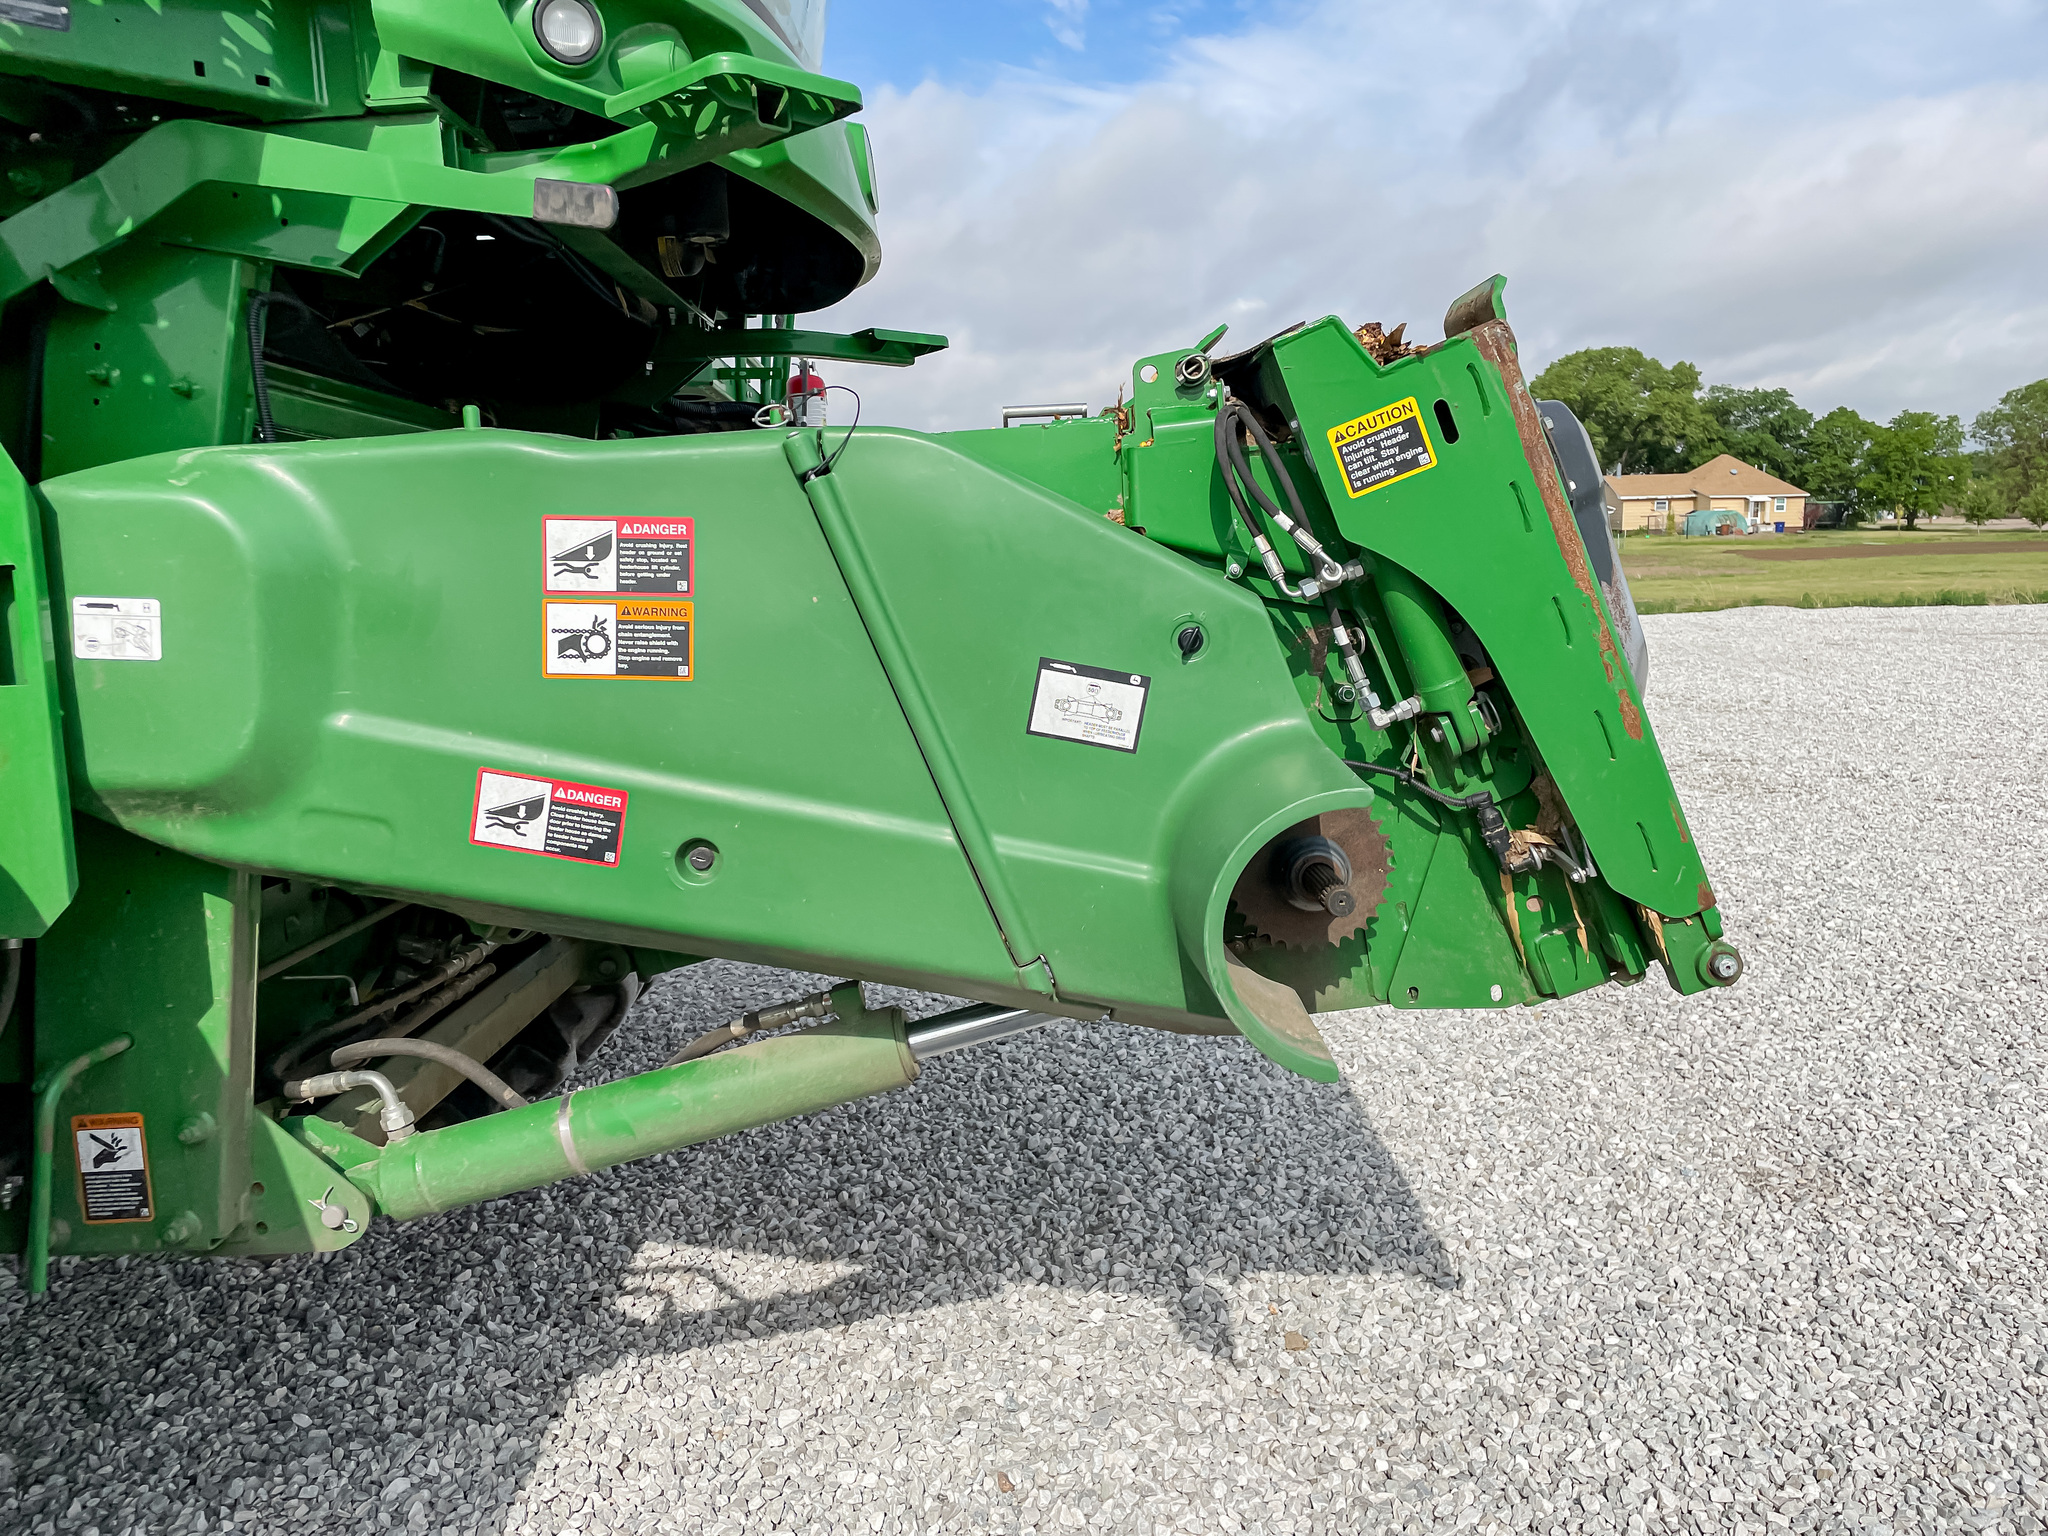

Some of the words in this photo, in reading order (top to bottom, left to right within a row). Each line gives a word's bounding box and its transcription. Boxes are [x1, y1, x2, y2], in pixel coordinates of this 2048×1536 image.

[1345, 402, 1413, 437] CAUTION
[1342, 439, 1366, 454] Avoid
[1367, 425, 1403, 444] crushing
[1380, 432, 1410, 448] Header
[1348, 461, 1363, 471] can
[1363, 455, 1378, 465] tilt.
[1380, 446, 1399, 457] Stay
[1351, 467, 1371, 479] clear
[1372, 458, 1394, 471] when
[1395, 447, 1423, 461] engine
[1363, 468, 1397, 484] running.
[633, 524, 687, 535] DANGER
[632, 607, 687, 617] WARNING
[567, 789, 621, 807] DANGER
